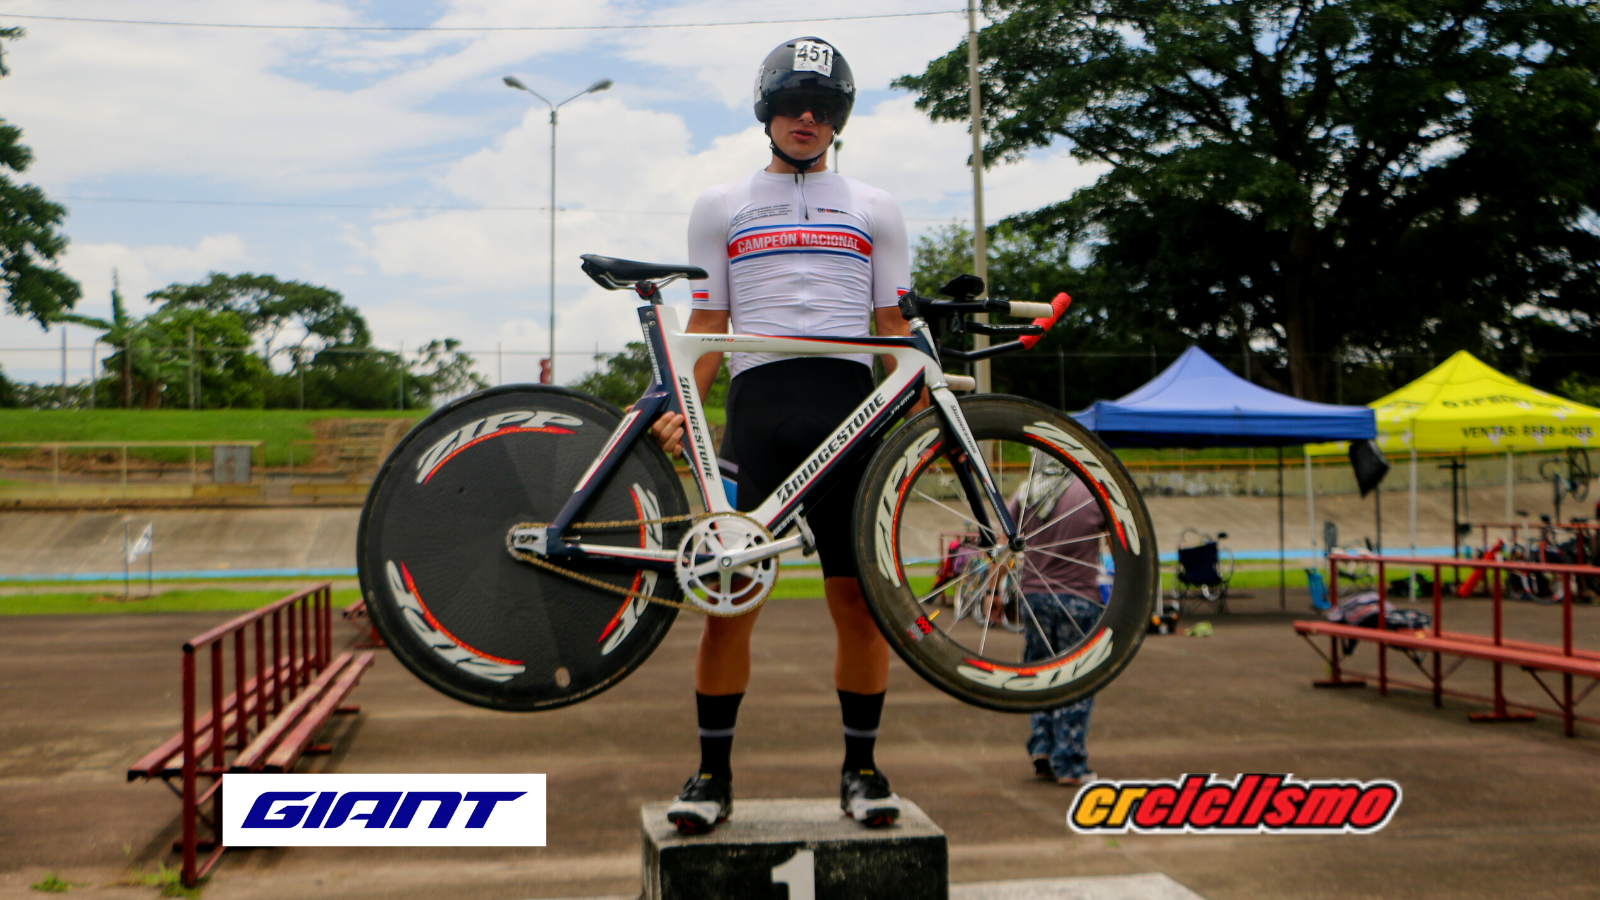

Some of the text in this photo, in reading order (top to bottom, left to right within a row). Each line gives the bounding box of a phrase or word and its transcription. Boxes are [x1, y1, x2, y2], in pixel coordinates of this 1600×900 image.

[797, 44, 829, 66] 451
[737, 231, 861, 254] CAMPEÓN NACIONAL
[415, 410, 584, 484] ZIPP
[677, 374, 715, 482] BRIDGESTONE
[776, 392, 887, 508] BRIDGESTONE
[875, 427, 940, 588] ZIPP
[1022, 421, 1141, 556] ZIPP
[386, 559, 526, 682] ZIPP
[956, 626, 1113, 691] ZIPP
[771, 849, 816, 900] 1
